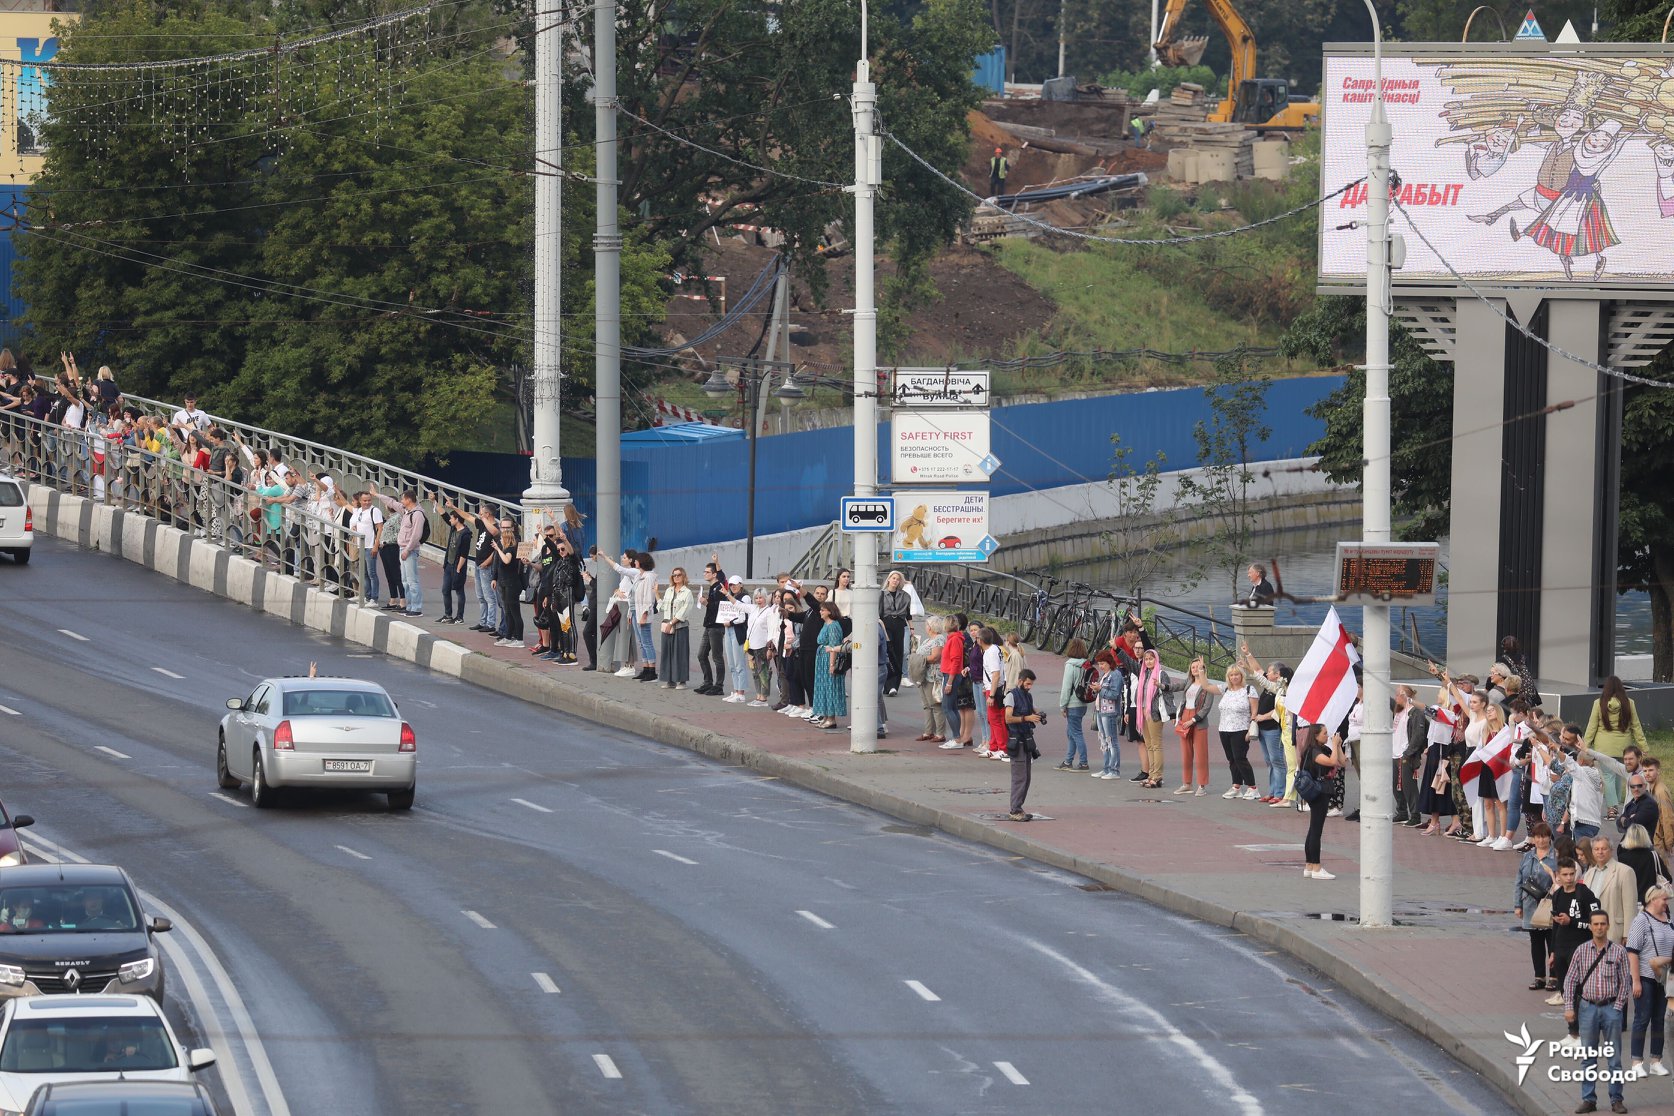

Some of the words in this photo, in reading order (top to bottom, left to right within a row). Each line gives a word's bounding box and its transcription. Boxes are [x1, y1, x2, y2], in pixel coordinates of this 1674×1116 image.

[1342, 91, 1421, 104] каштўнасці
[1340, 183, 1464, 209] ДАРАБЫТ
[900, 431, 940, 441] SAFETY
[943, 431, 974, 441] FIRST
[963, 496, 984, 505] ДЕТИ
[933, 505, 986, 513] БЕССТРАШНЫ.
[936, 515, 971, 525] Берегите
[972, 516, 984, 524] их!
[332, 761, 349, 770] 8591
